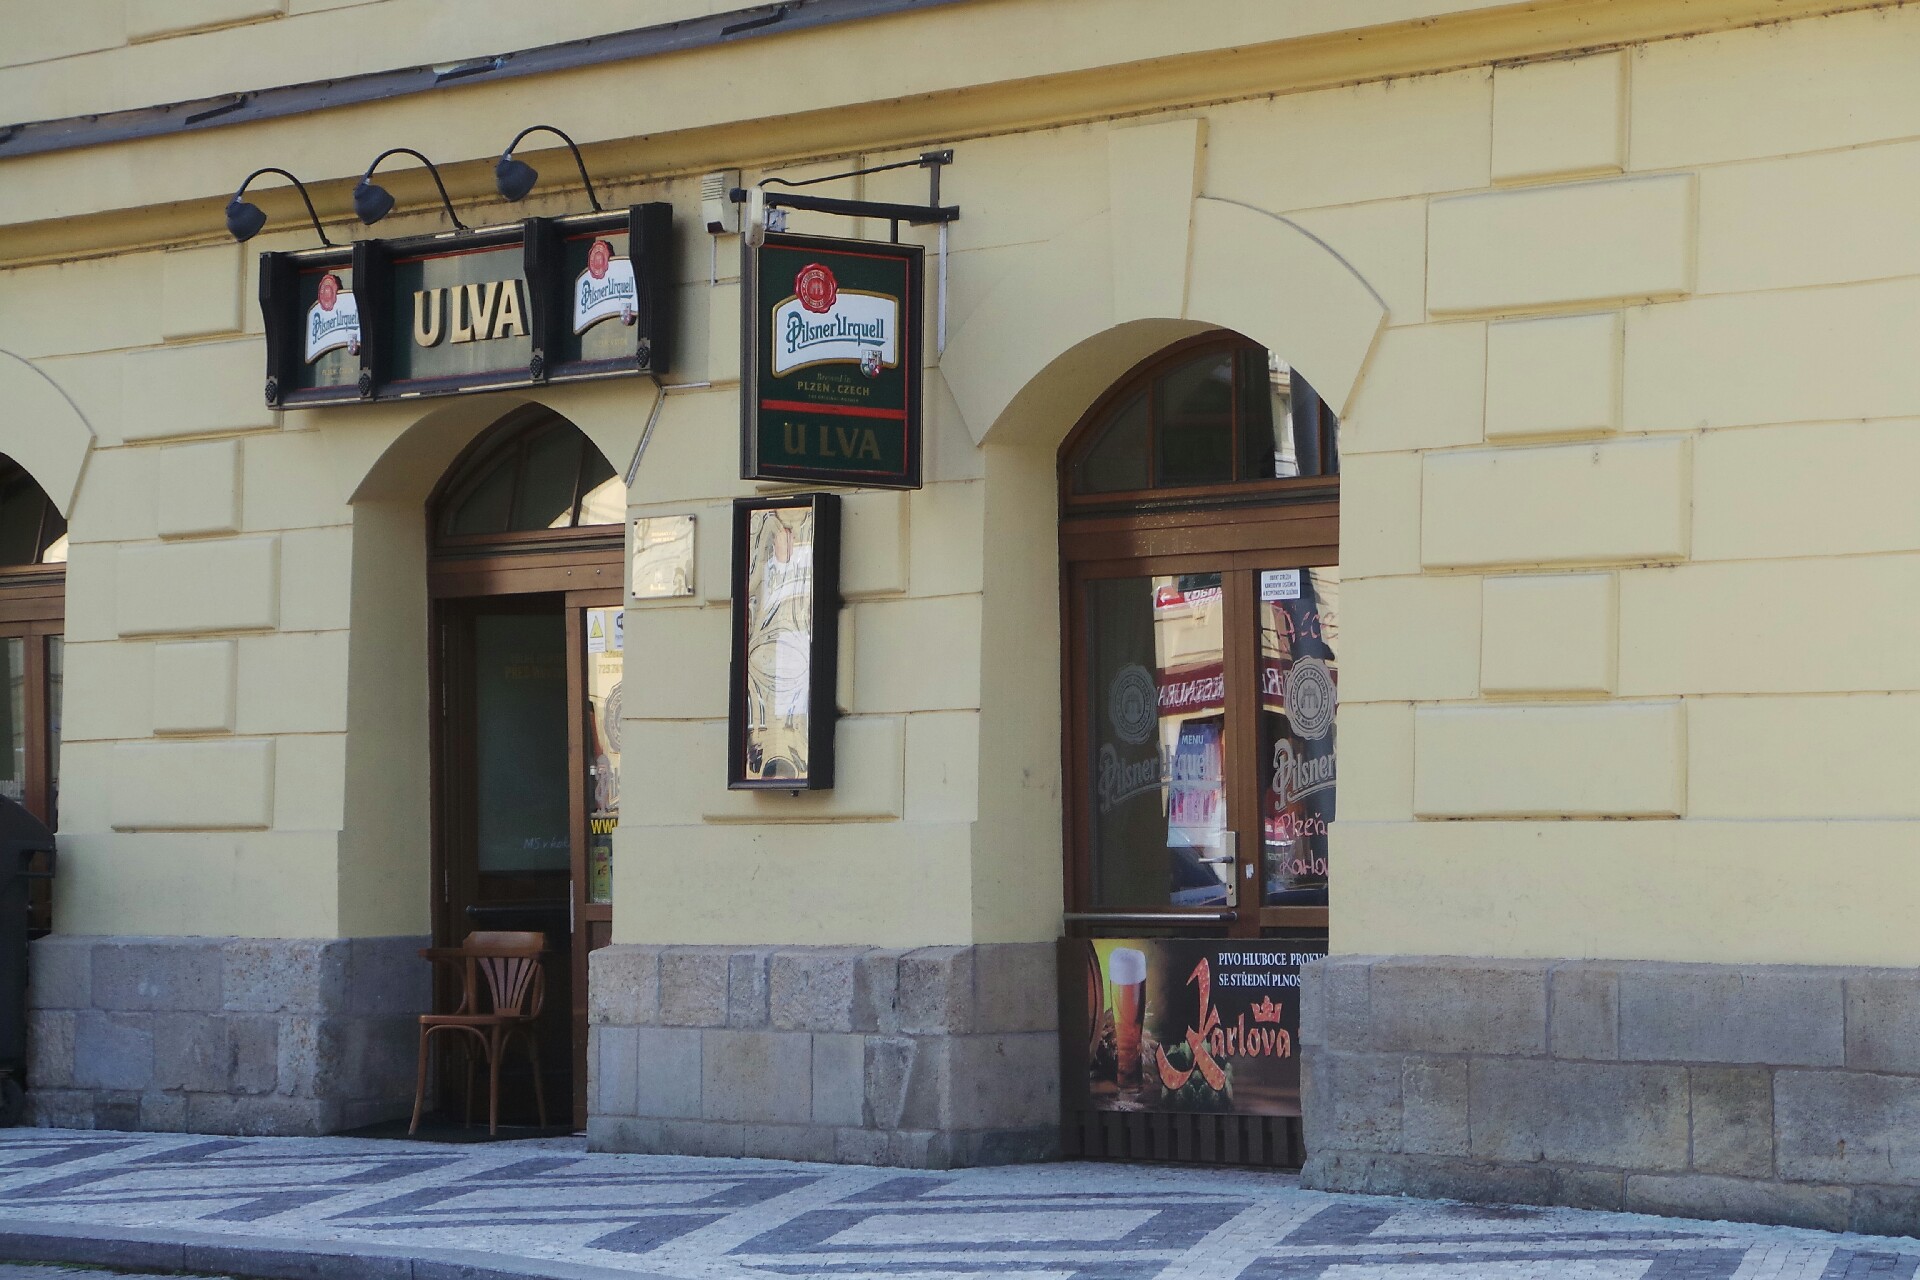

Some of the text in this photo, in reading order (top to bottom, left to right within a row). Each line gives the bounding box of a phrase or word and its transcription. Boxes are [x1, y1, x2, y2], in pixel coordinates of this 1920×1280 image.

[413, 279, 526, 347] U LVA
[581, 280, 609, 314] Pilsner
[786, 311, 884, 353] Pilsner Urquell
[837, 385, 870, 396] CZECH
[784, 423, 881, 460] U LVA
[1181, 734, 1204, 745] MENU
[1273, 738, 1336, 812] Pilsner
[1219, 952, 1241, 966] PIVO
[1242, 952, 1288, 966] HLUBOCE
[1219, 973, 1230, 986] SE
[1231, 971, 1271, 987] STŘEDNÍ
[1156, 957, 1291, 1091] Karlova
